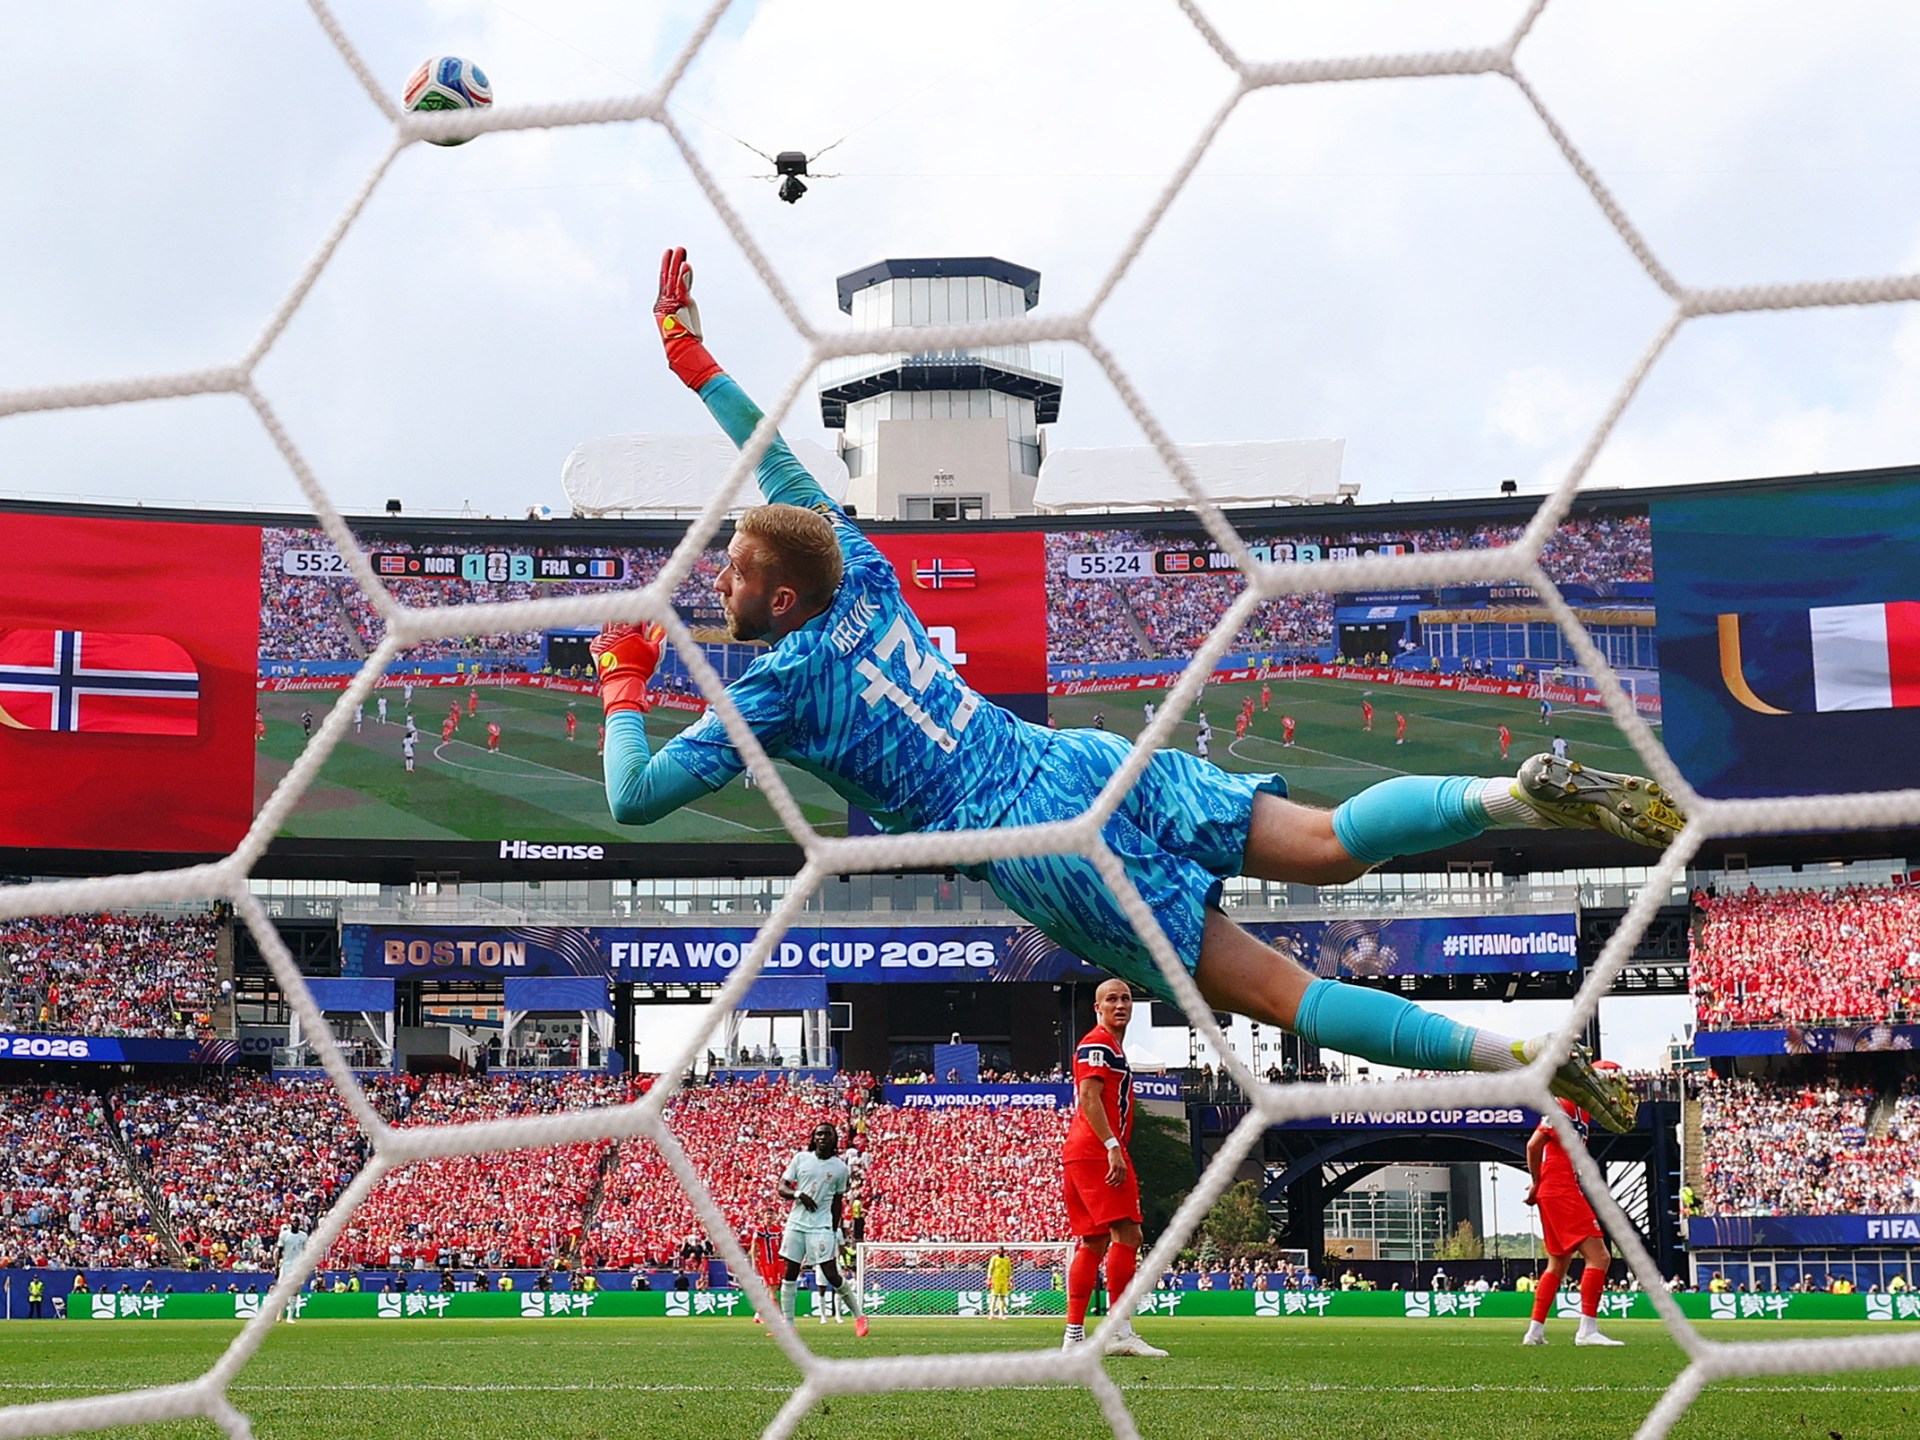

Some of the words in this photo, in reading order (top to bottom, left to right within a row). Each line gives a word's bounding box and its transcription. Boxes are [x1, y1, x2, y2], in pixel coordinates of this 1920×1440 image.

[296, 554, 349, 571] 55:2
[424, 557, 456, 573] NOR
[469, 559, 478, 575] 1
[516, 560, 527, 575] 3
[541, 559, 570, 576] FRA
[1080, 555, 1141, 574] 55:24
[830, 594, 881, 656] SELVIK
[462, 673, 521, 686] Budweiser
[1253, 667, 1314, 680] Budweiser
[1393, 670, 1436, 688] Budweiser
[271, 677, 341, 691] Budweiser
[855, 613, 979, 755] 13
[1062, 680, 1131, 695] Budweiser
[1456, 677, 1503, 695] Budweiser
[500, 840, 604, 860] Hisense
[384, 940, 526, 967] BOSTON
[610, 942, 680, 968] FIFA
[808, 941, 875, 968] CUP
[880, 941, 995, 968] 2026
[12, 1038, 89, 1058] 2026
[902, 1094, 933, 1106] FIFA
[933, 1094, 981, 1106] WORLD
[982, 1094, 1009, 1106] CUP
[1010, 1094, 1057, 1105] 2026
[1331, 1111, 1366, 1124] FIFA
[1367, 1110, 1428, 1124] WORLD
[1430, 1109, 1463, 1123] CUP
[1465, 1109, 1524, 1124] 2026
[1866, 1219, 1920, 1239] FIFA
[120, 1294, 165, 1318] 蒙牛
[405, 1292, 451, 1317] 蒙牛
[549, 1292, 595, 1317] 蒙牛
[694, 1291, 739, 1316] 蒙牛
[1284, 1292, 1330, 1316] 蒙牛
[1434, 1292, 1482, 1317] 蒙牛
[1740, 1294, 1789, 1319] 蒙牛
